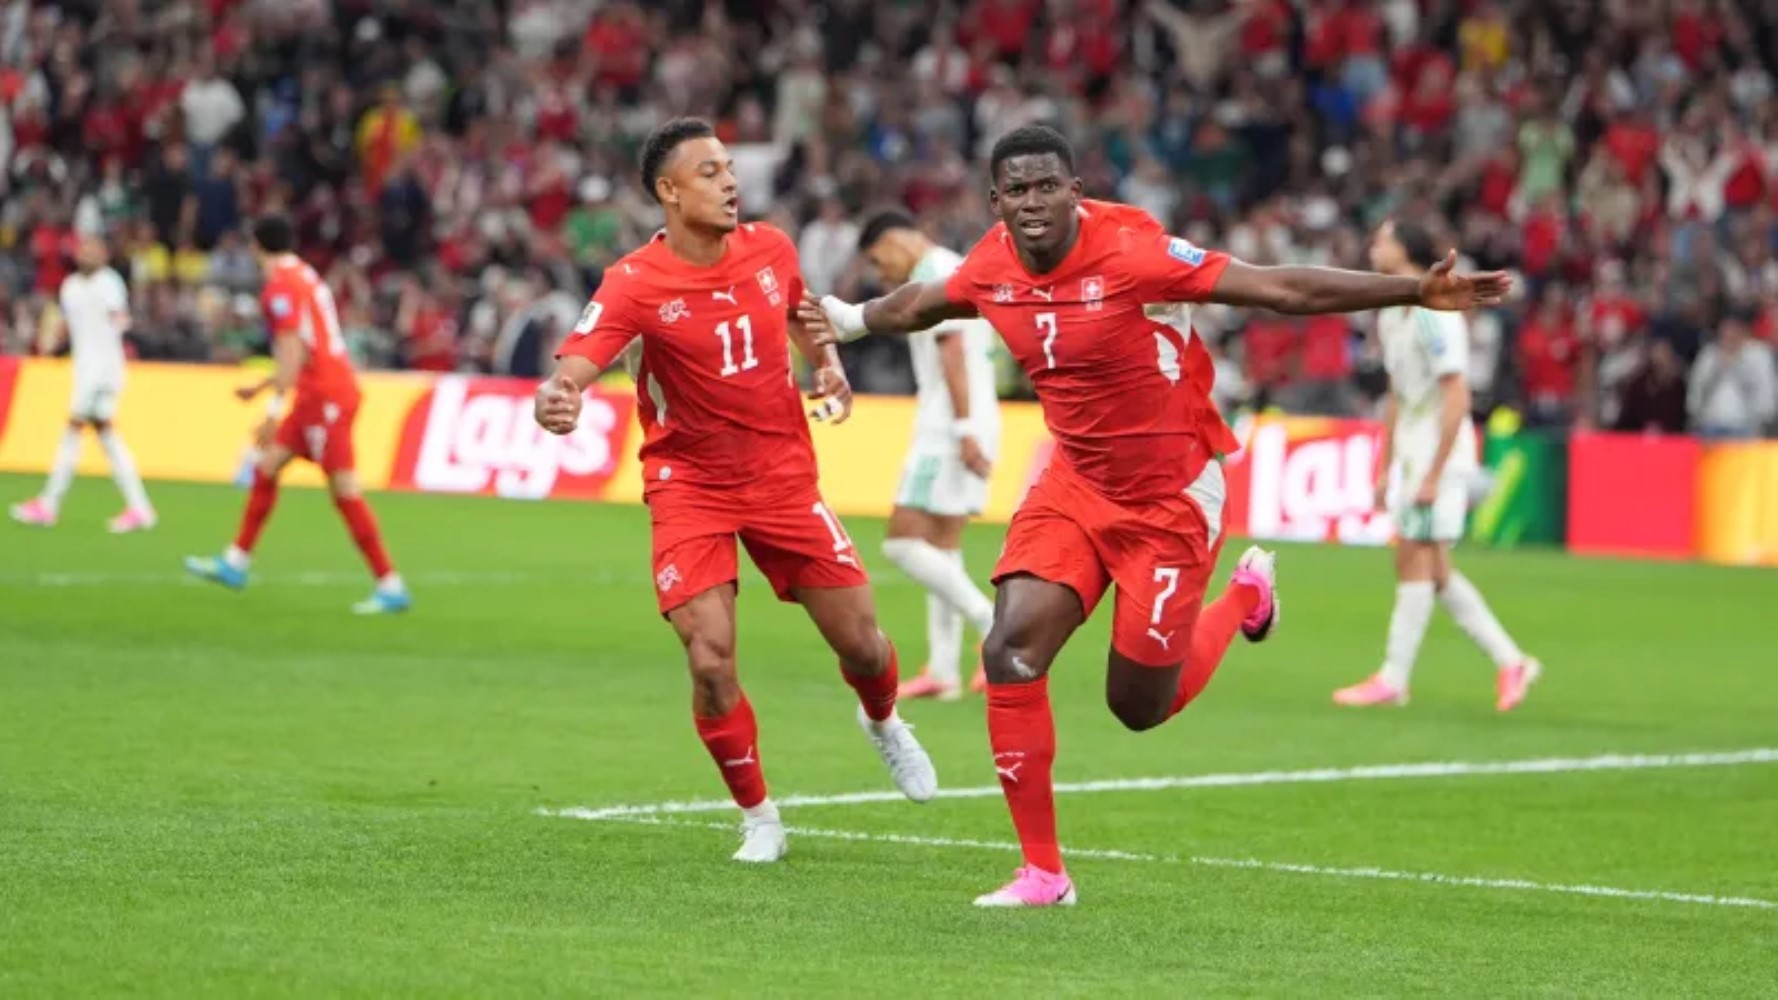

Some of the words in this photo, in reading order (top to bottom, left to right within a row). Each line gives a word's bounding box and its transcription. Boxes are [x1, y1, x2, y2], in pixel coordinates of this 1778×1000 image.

[714, 314, 759, 377] 11
[1035, 312, 1057, 369] 7
[415, 373, 616, 500] Lays
[1151, 567, 1180, 624] 7
